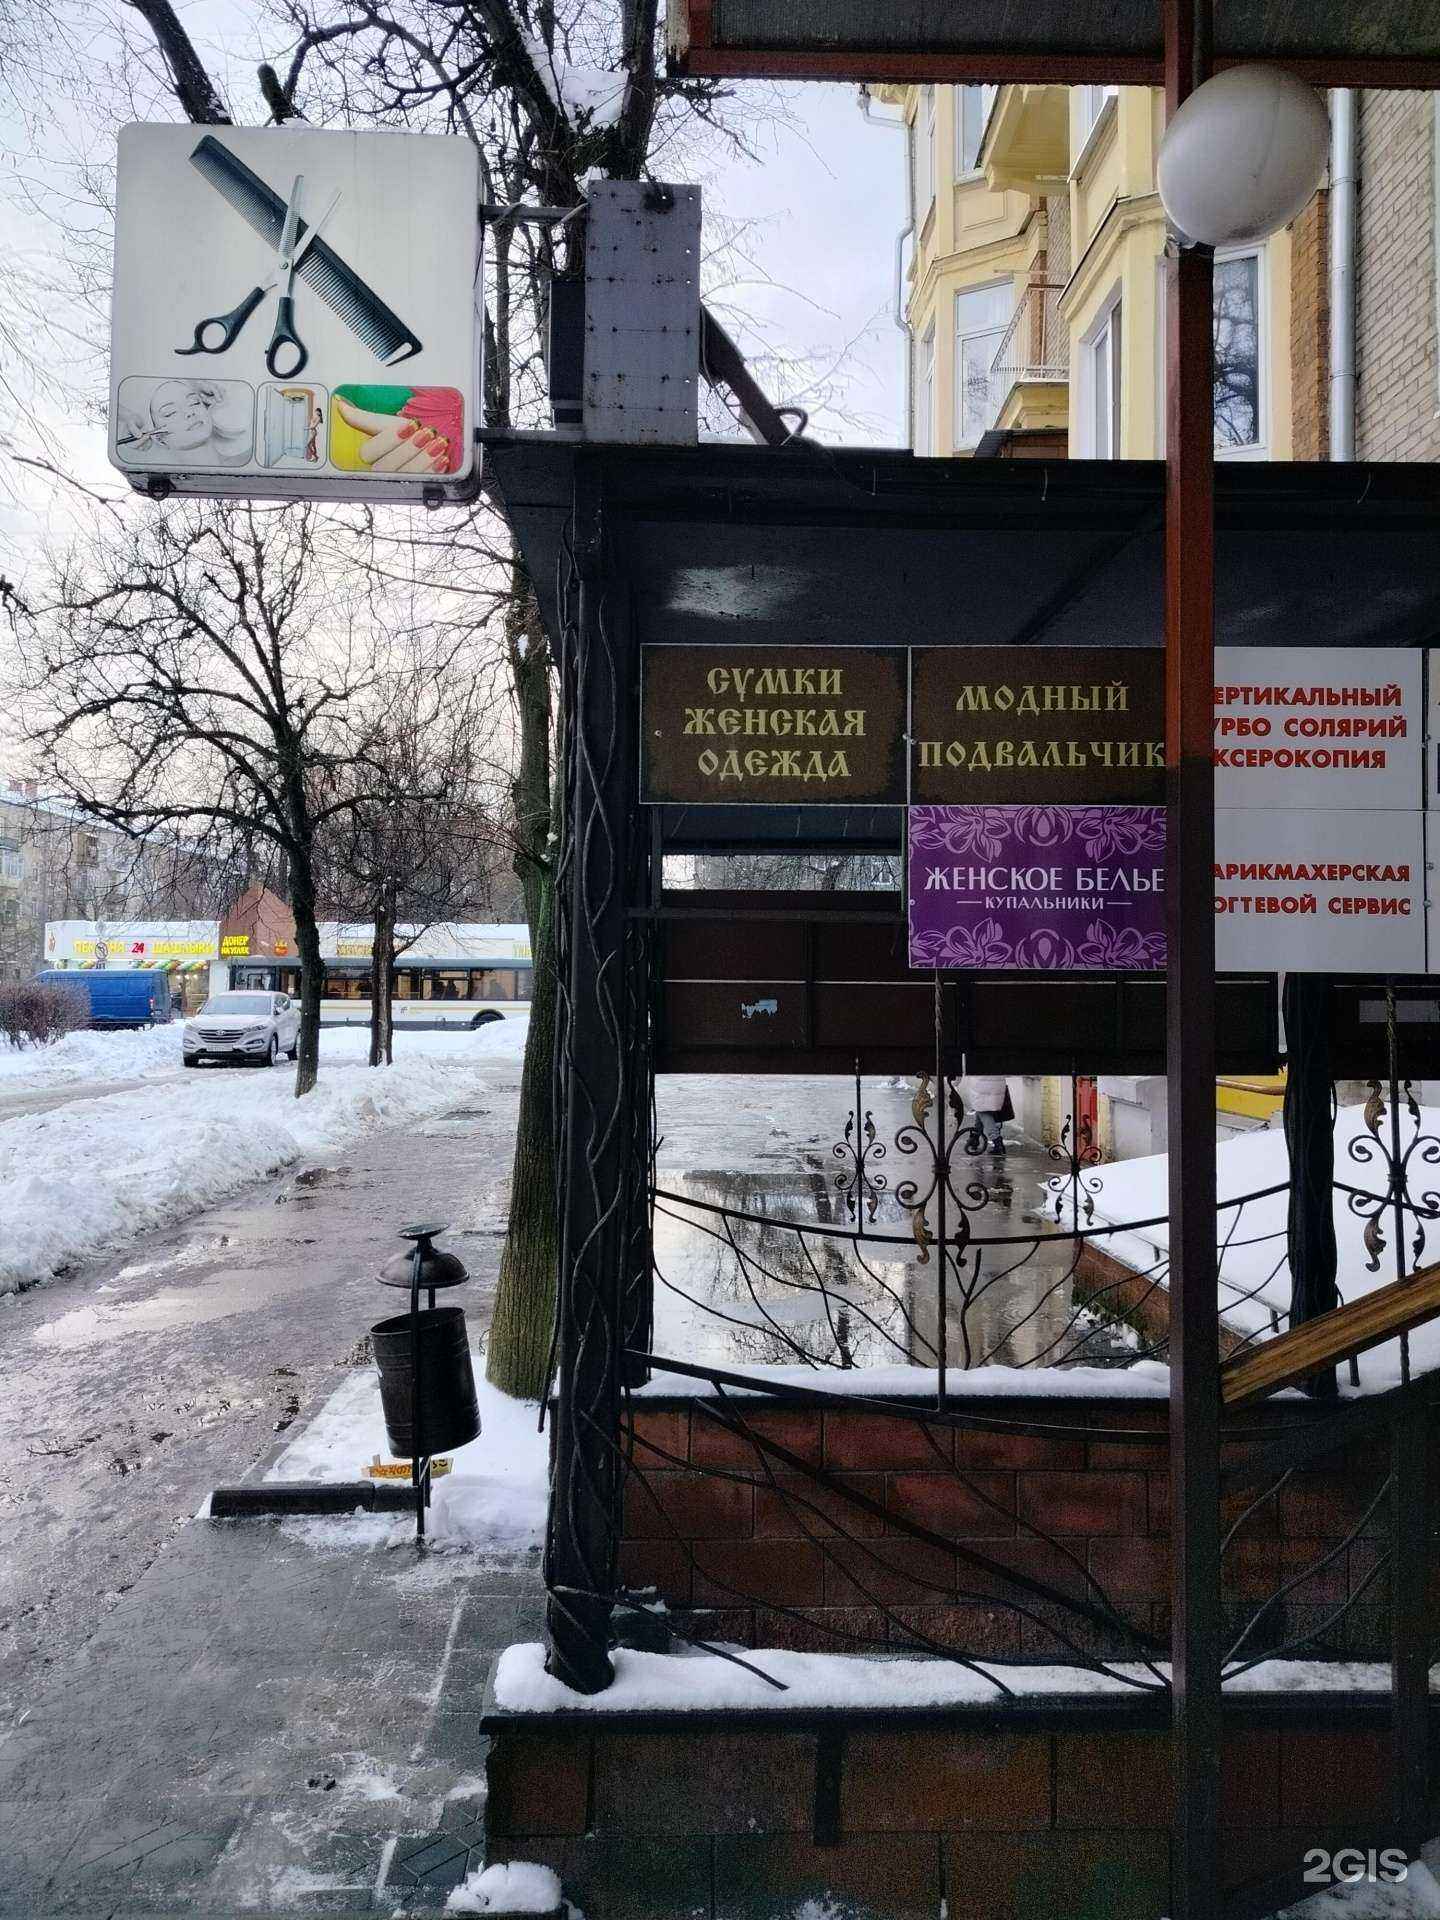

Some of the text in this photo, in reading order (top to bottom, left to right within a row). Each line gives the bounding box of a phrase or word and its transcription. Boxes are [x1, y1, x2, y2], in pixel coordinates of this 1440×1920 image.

[706, 667, 844, 702] СУМКИ
[1213, 684, 1402, 707] ЕРТИКАЛЬНЫЙ
[955, 680, 1129, 716] МОДНЫЙ
[682, 707, 867, 736] ЖЕНСКАЯ
[1283, 715, 1408, 739] СОЛЯРИЙ
[697, 748, 852, 782] ОДЕЖДА
[917, 739, 1168, 772] ПОДВАЛЬЧИК
[1211, 748, 1387, 769] КСЕРОКОПИЯ
[923, 866, 1166, 892] ЖЕНСКОЕ БЕЛЬЕ
[1212, 862, 1411, 882] АРИКМАХЕРСКАЯ
[984, 896, 1105, 910] КУПАЛЬНИКИ
[1213, 893, 1412, 916] ОГТЕВОЙ СЕРВИС
[131, 941, 146, 954] 24
